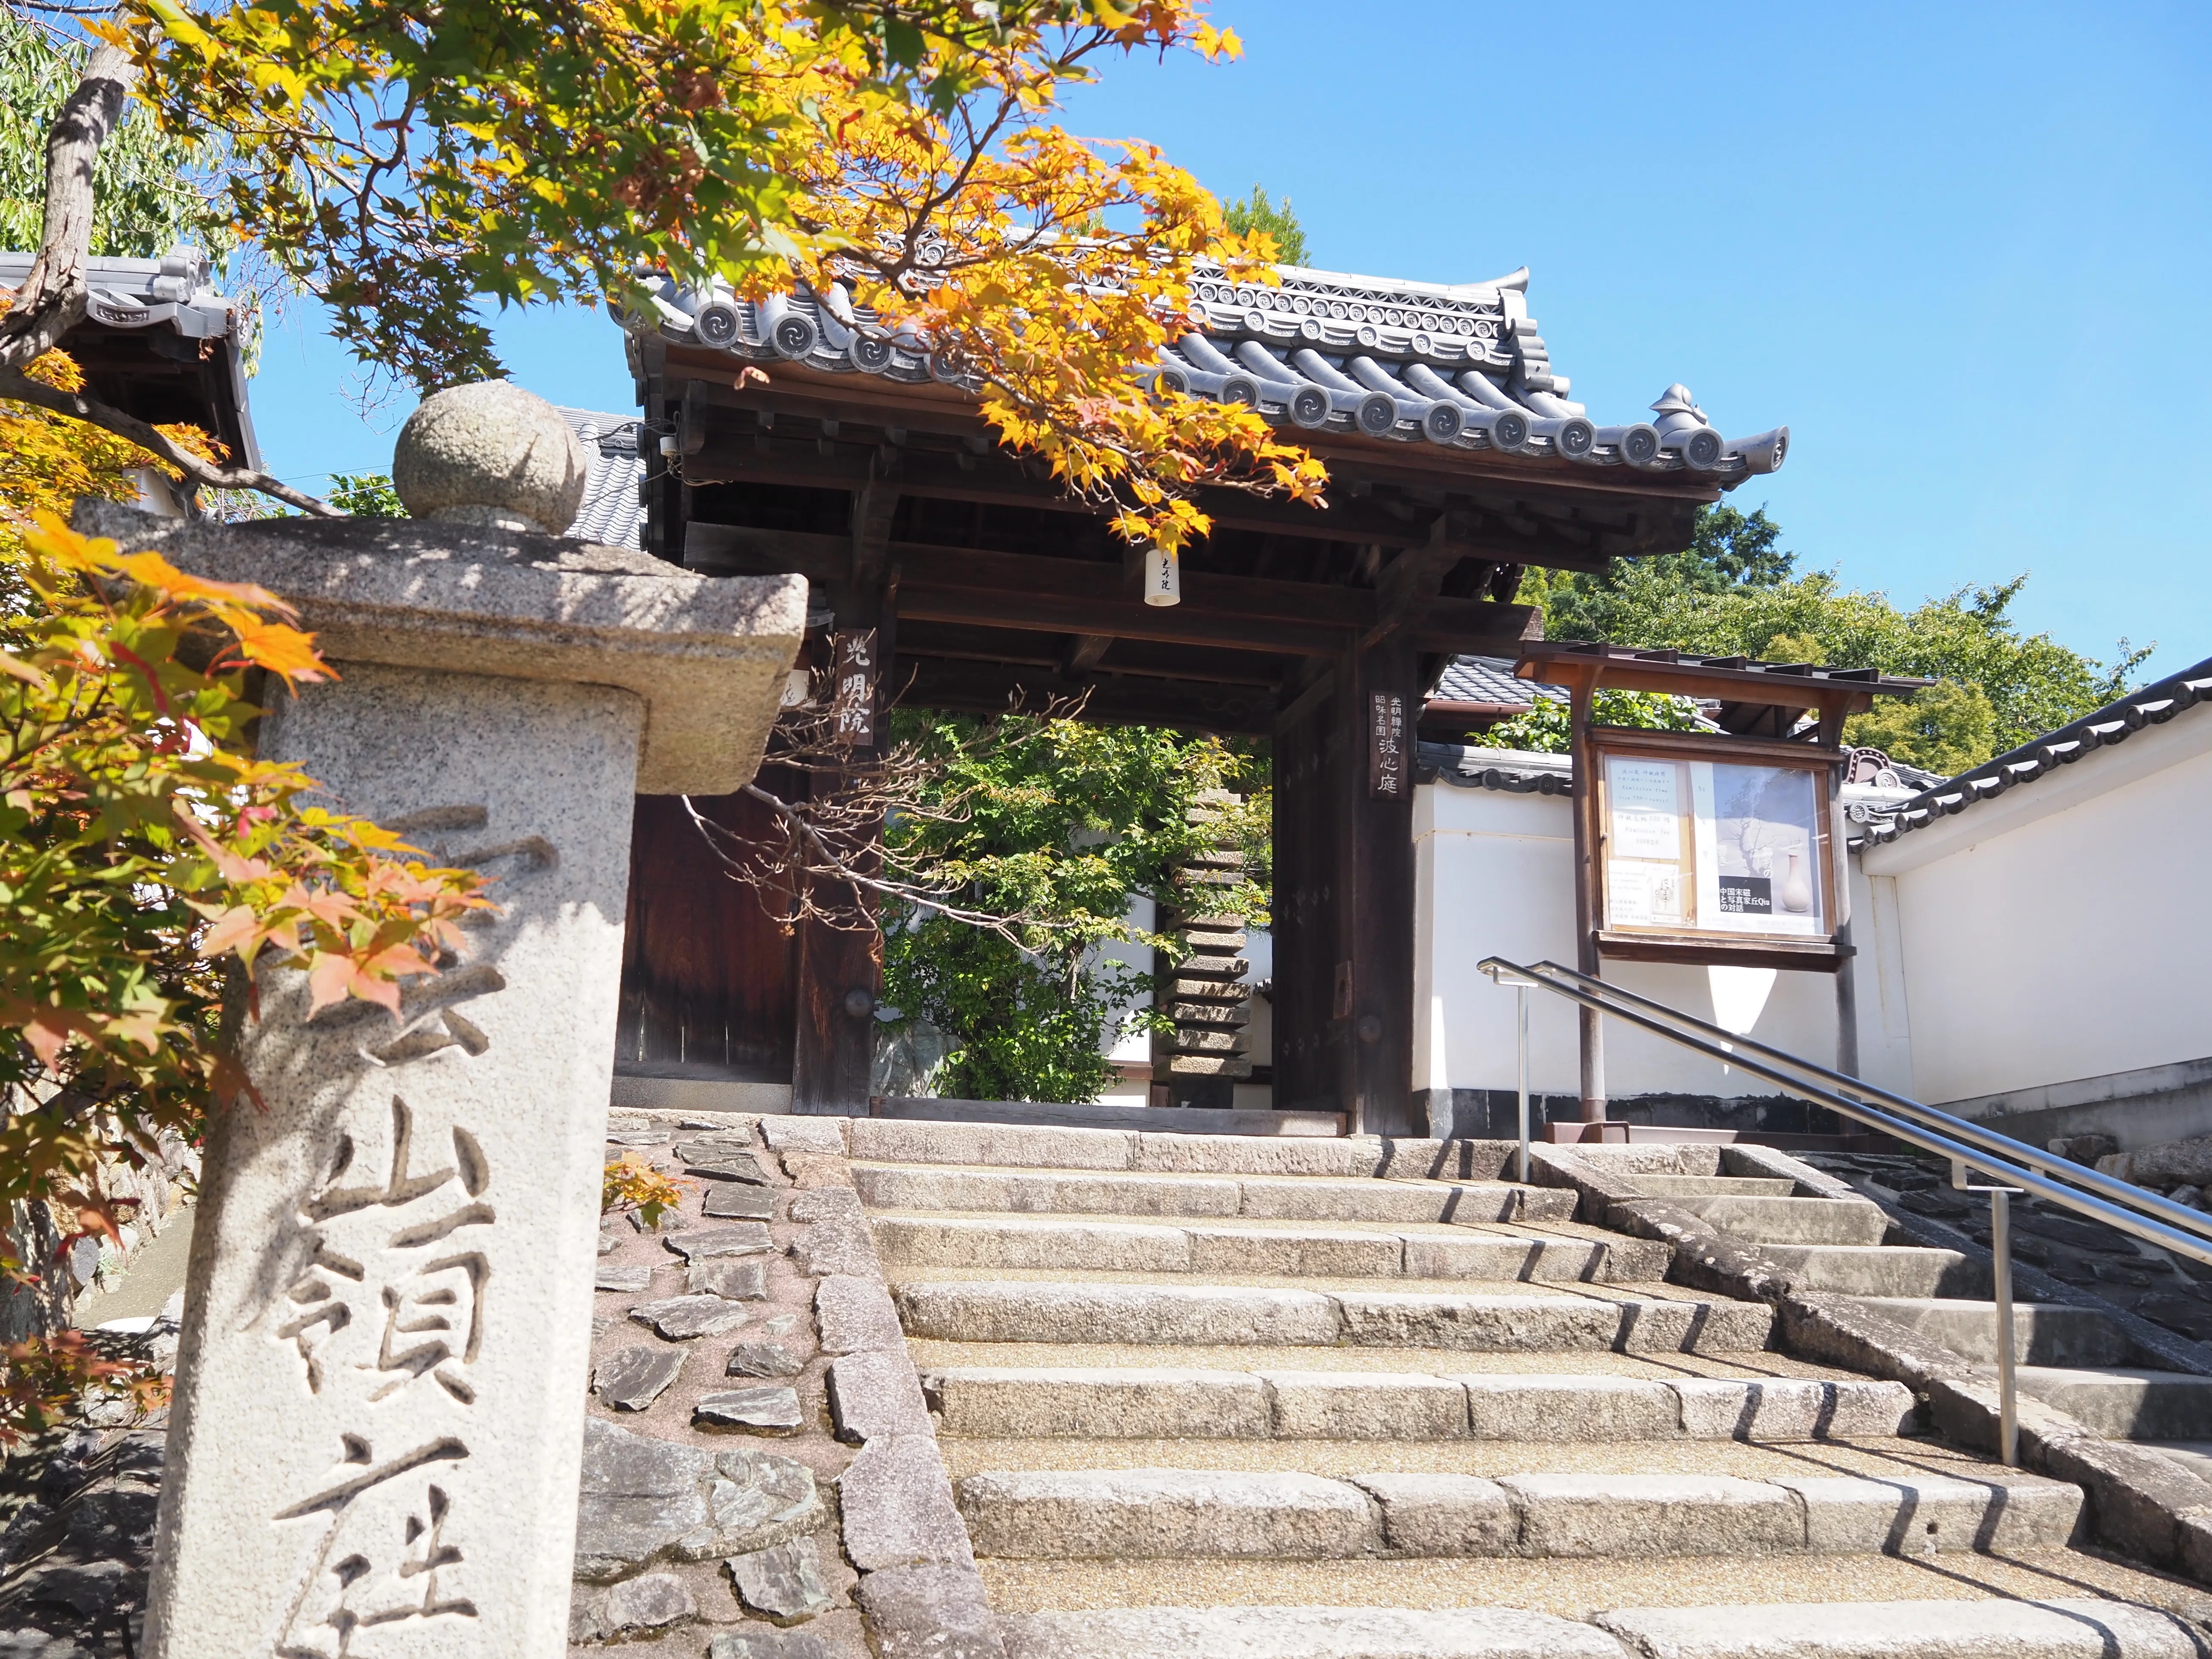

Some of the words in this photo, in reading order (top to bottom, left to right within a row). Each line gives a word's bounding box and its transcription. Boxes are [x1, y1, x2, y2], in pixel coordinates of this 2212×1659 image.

[1161, 558, 1171, 590] 光明院
[839, 638, 870, 733] 光明院
[1377, 737, 1400, 794] 波心庭
[1720, 888, 1751, 896] 中国宋磁
[1721, 904, 1744, 912] の対話
